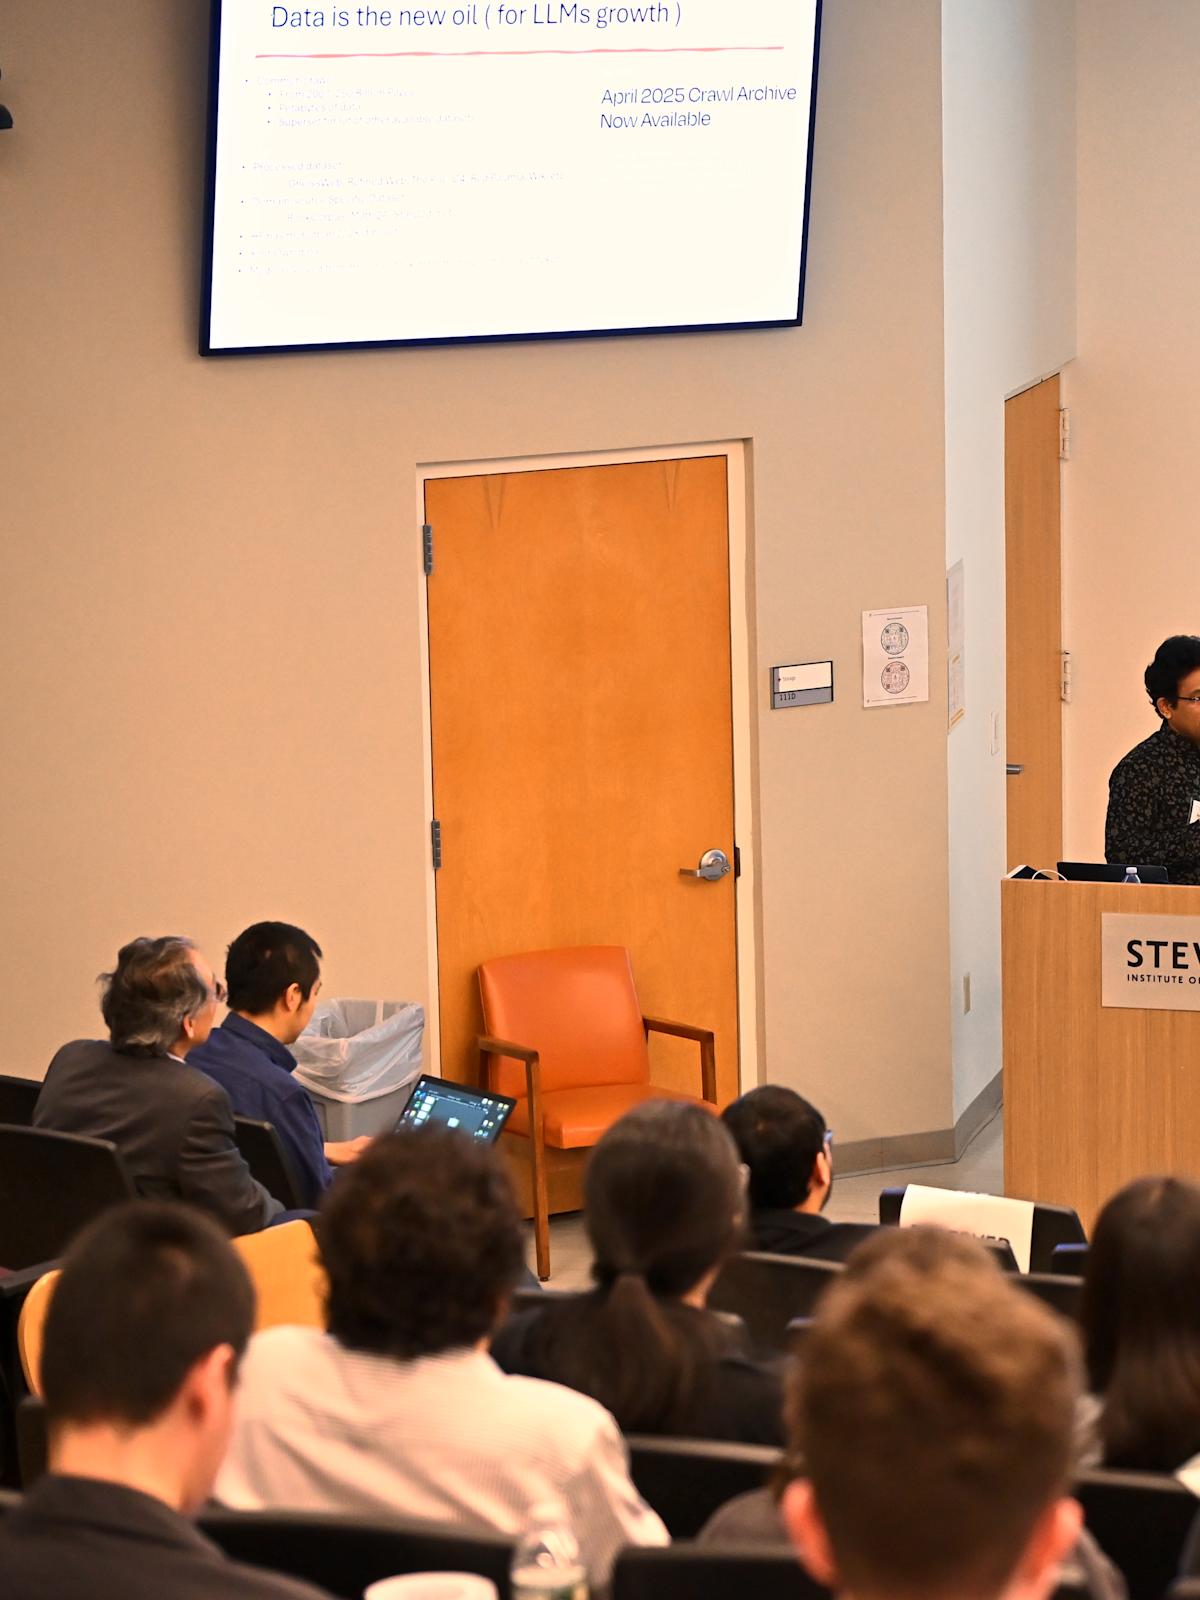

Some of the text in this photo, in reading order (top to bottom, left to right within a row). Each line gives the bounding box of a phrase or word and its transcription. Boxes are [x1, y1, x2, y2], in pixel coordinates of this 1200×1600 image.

[272, 6, 325, 28] Data
[332, 5, 350, 27] is
[356, 5, 392, 27] the
[399, 9, 446, 26] new
[452, 4, 478, 26] oil
[497, 3, 528, 25] for
[533, 3, 591, 25] LLMs
[595, 1, 669, 29] growth
[600, 85, 797, 108] April 2025 Crawl Archive
[600, 111, 711, 129] Now Available
[1126, 974, 1184, 984] INSTITUTE
